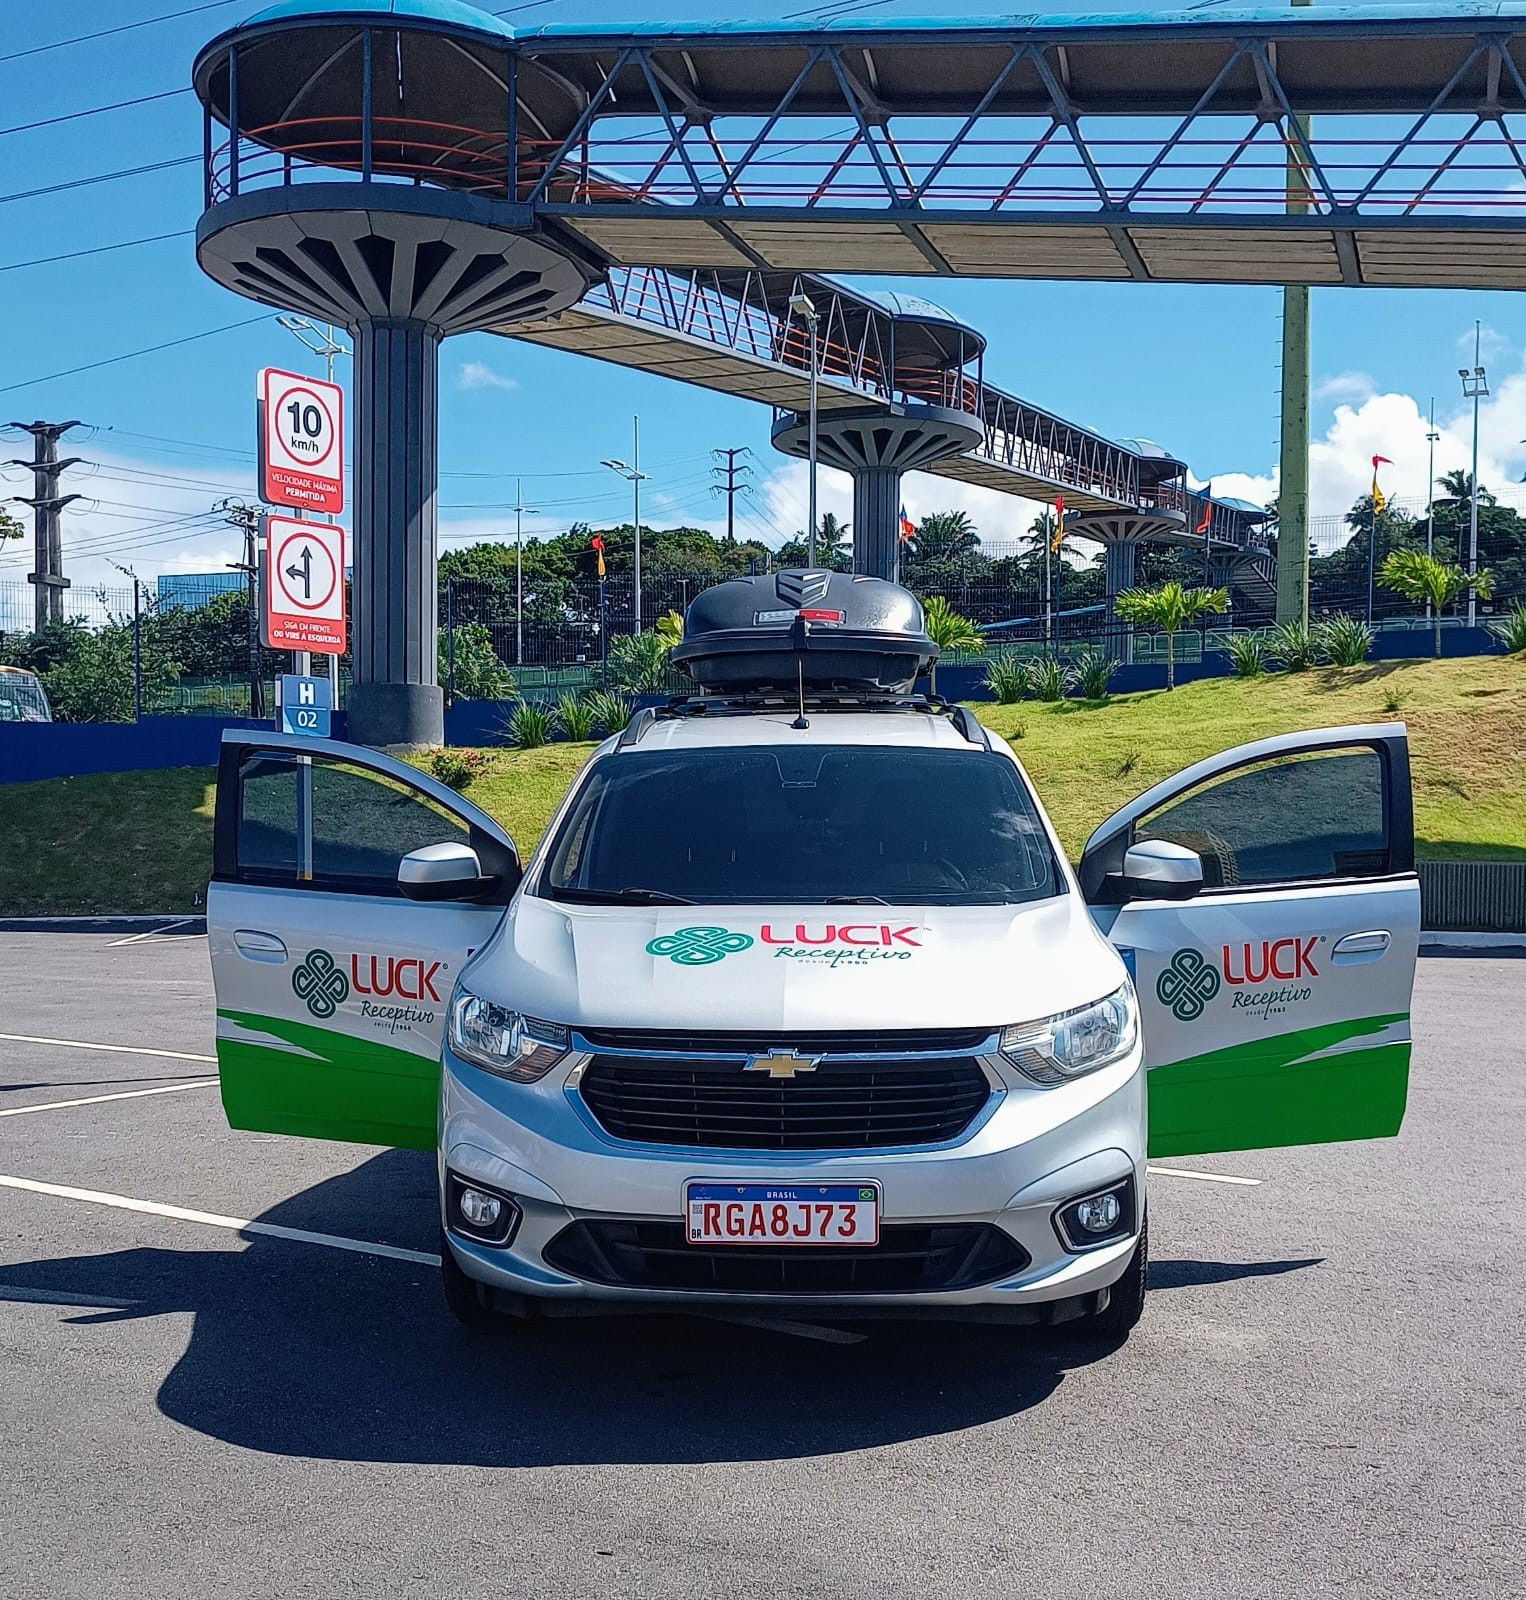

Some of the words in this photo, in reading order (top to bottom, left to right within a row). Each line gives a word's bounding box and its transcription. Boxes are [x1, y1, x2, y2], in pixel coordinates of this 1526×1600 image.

[288, 401, 322, 438] 10
[291, 436, 319, 453] km/h
[272, 472, 312, 488] VELOCIDADE
[285, 487, 325, 502] PERMITIDA
[273, 630, 284, 638] OU
[285, 631, 300, 640] VIRE
[307, 634, 341, 644] ESQUERDA
[284, 621, 298, 630] SIGA
[309, 624, 331, 633] FRENTE
[300, 683, 314, 705] H
[297, 711, 318, 728] 02
[761, 925, 923, 947] LUCK
[774, 946, 912, 968] Receptivo
[1223, 936, 1319, 984] LUCK
[351, 954, 441, 1001] LUCK
[1231, 984, 1312, 1020] Receptivo
[361, 1000, 434, 1034] Receptivo
[767, 1191, 798, 1199] BRASIL
[703, 1203, 856, 1237] RGA8J73
[691, 1229, 702, 1239] BR
